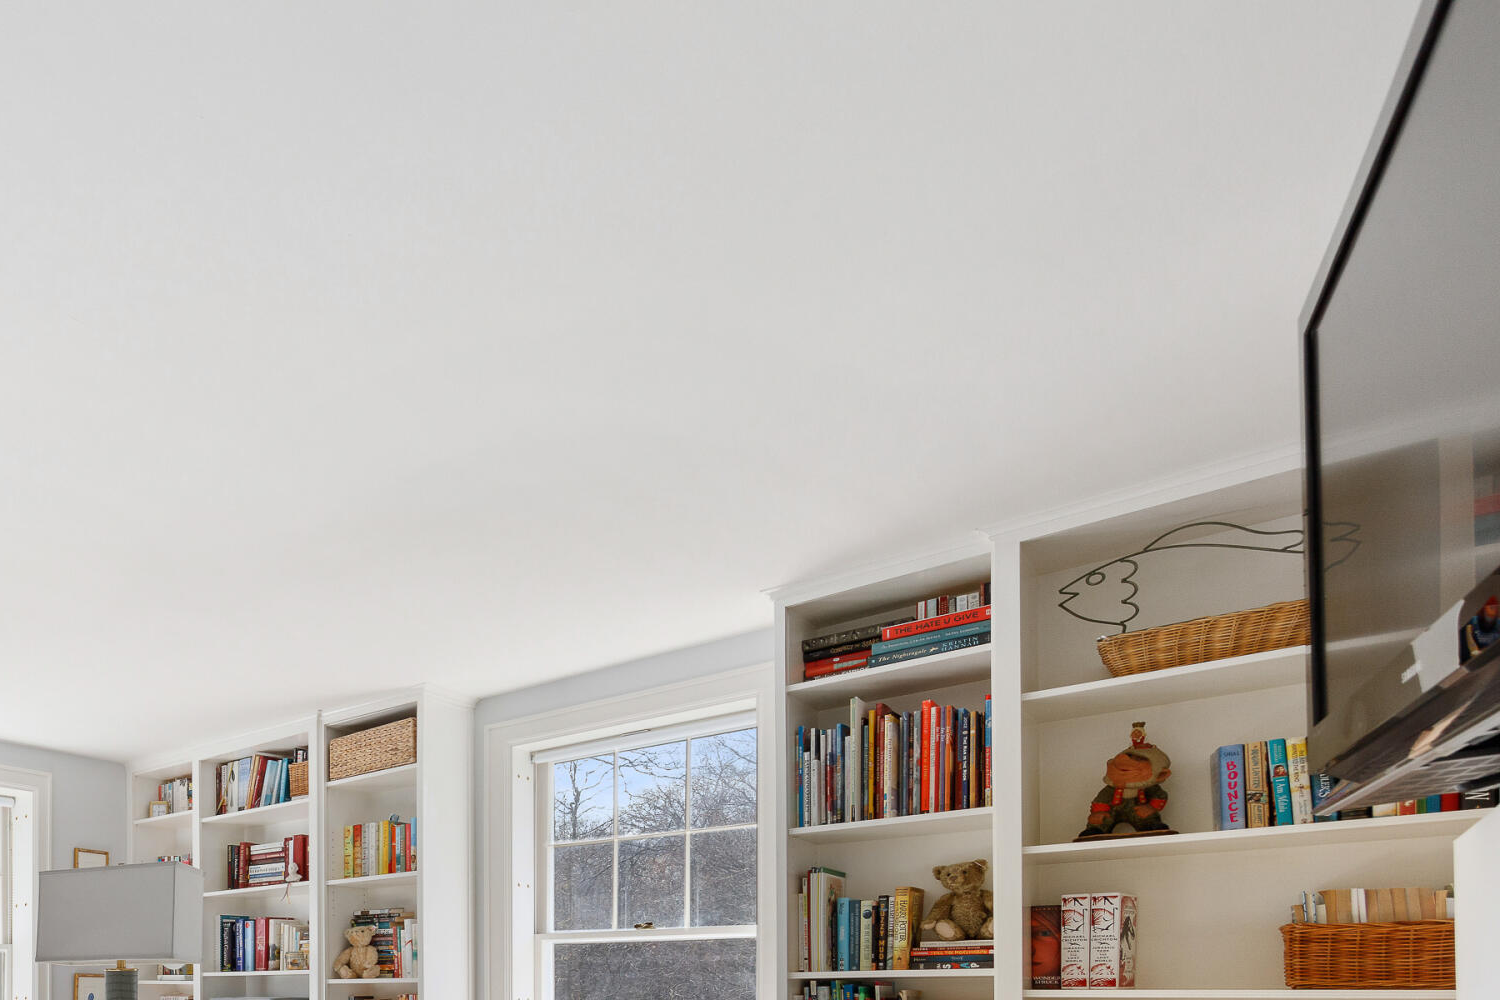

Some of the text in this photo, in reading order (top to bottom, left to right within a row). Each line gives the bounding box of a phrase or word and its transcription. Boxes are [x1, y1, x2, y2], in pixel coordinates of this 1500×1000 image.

[893, 610, 979, 636] THE HATE U GIVE
[1226, 760, 1239, 823] BOUNCE
[898, 899, 908, 943] HARRY POTTER
